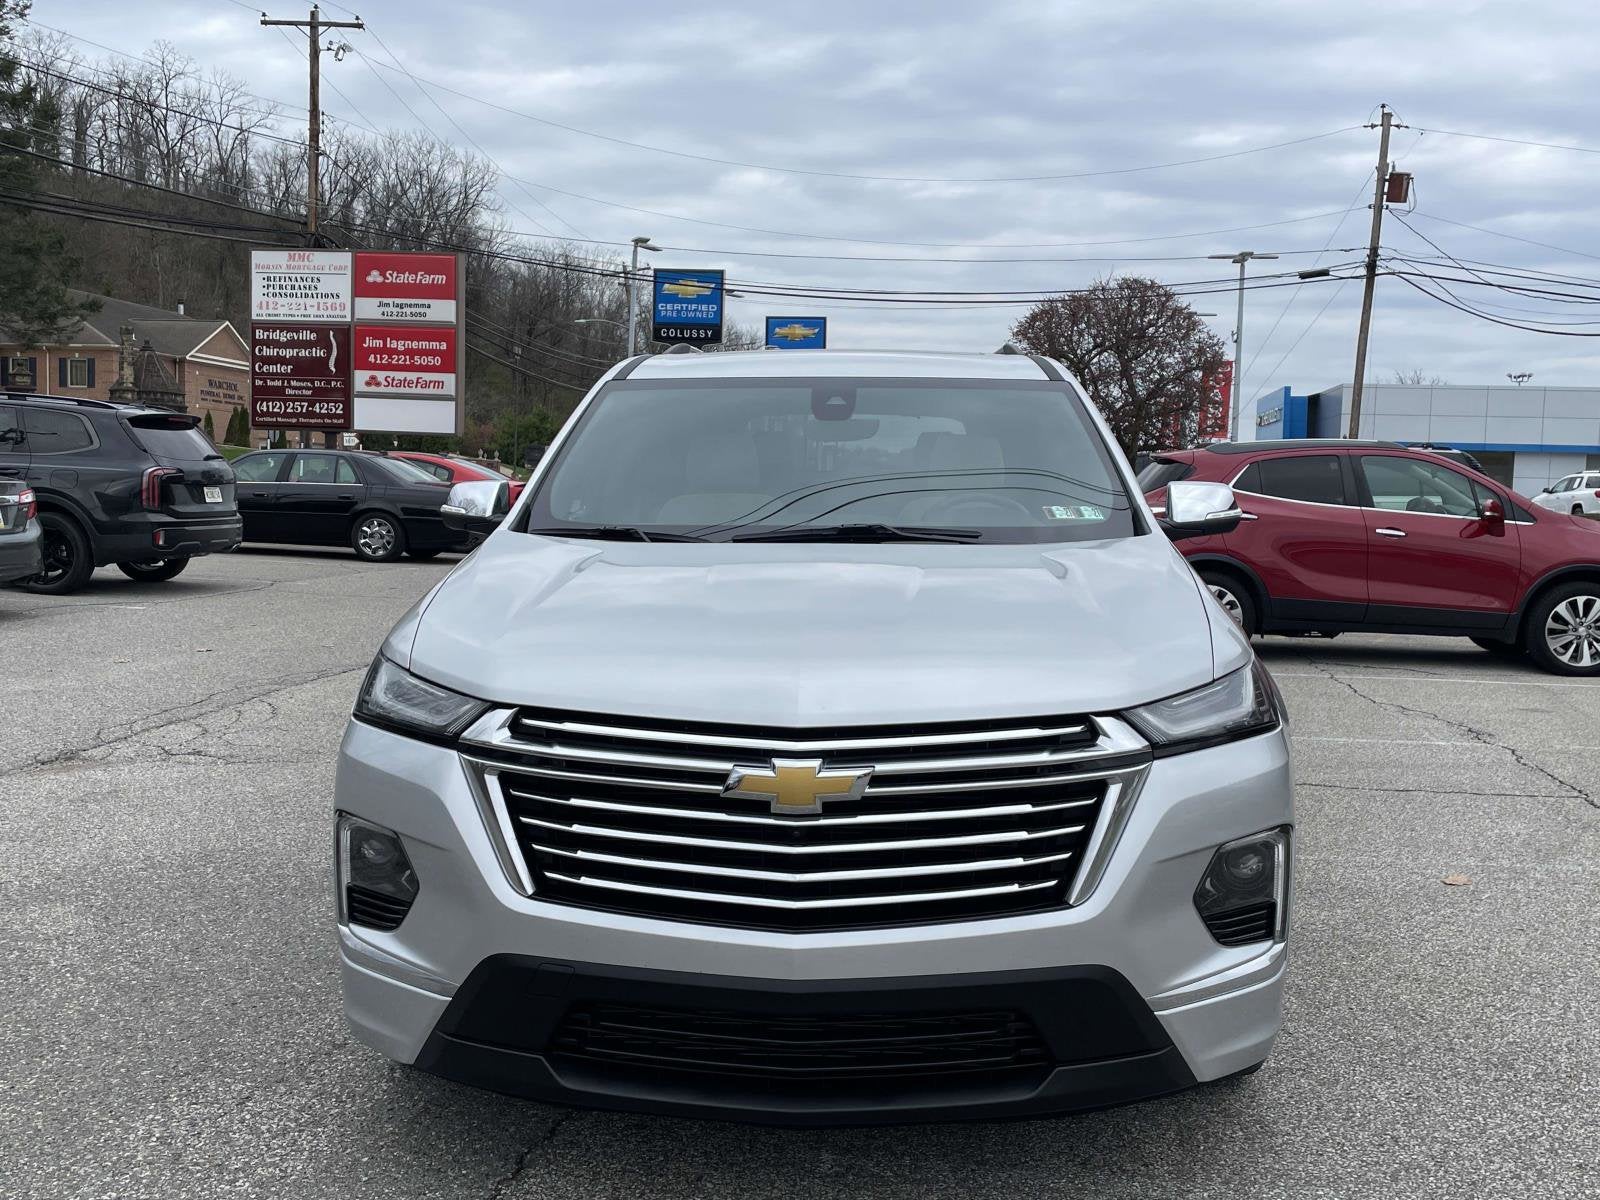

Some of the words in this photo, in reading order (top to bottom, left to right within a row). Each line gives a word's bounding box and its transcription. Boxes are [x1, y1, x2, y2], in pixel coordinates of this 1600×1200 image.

[287, 252, 314, 262] MMC
[266, 291, 340, 299] CONSOLIDATIONS
[256, 301, 346, 311] 412-221-1569
[392, 301, 431, 309] Iagnemma
[658, 303, 717, 311] CERTIFIED
[255, 329, 317, 342] Bridgeville
[661, 328, 712, 338] COLUSSY
[363, 337, 383, 348] Jim
[387, 337, 447, 350] Iagnemma
[255, 346, 327, 358] Chiropractic
[368, 354, 441, 365] 412-221-5050
[255, 362, 293, 373] Center
